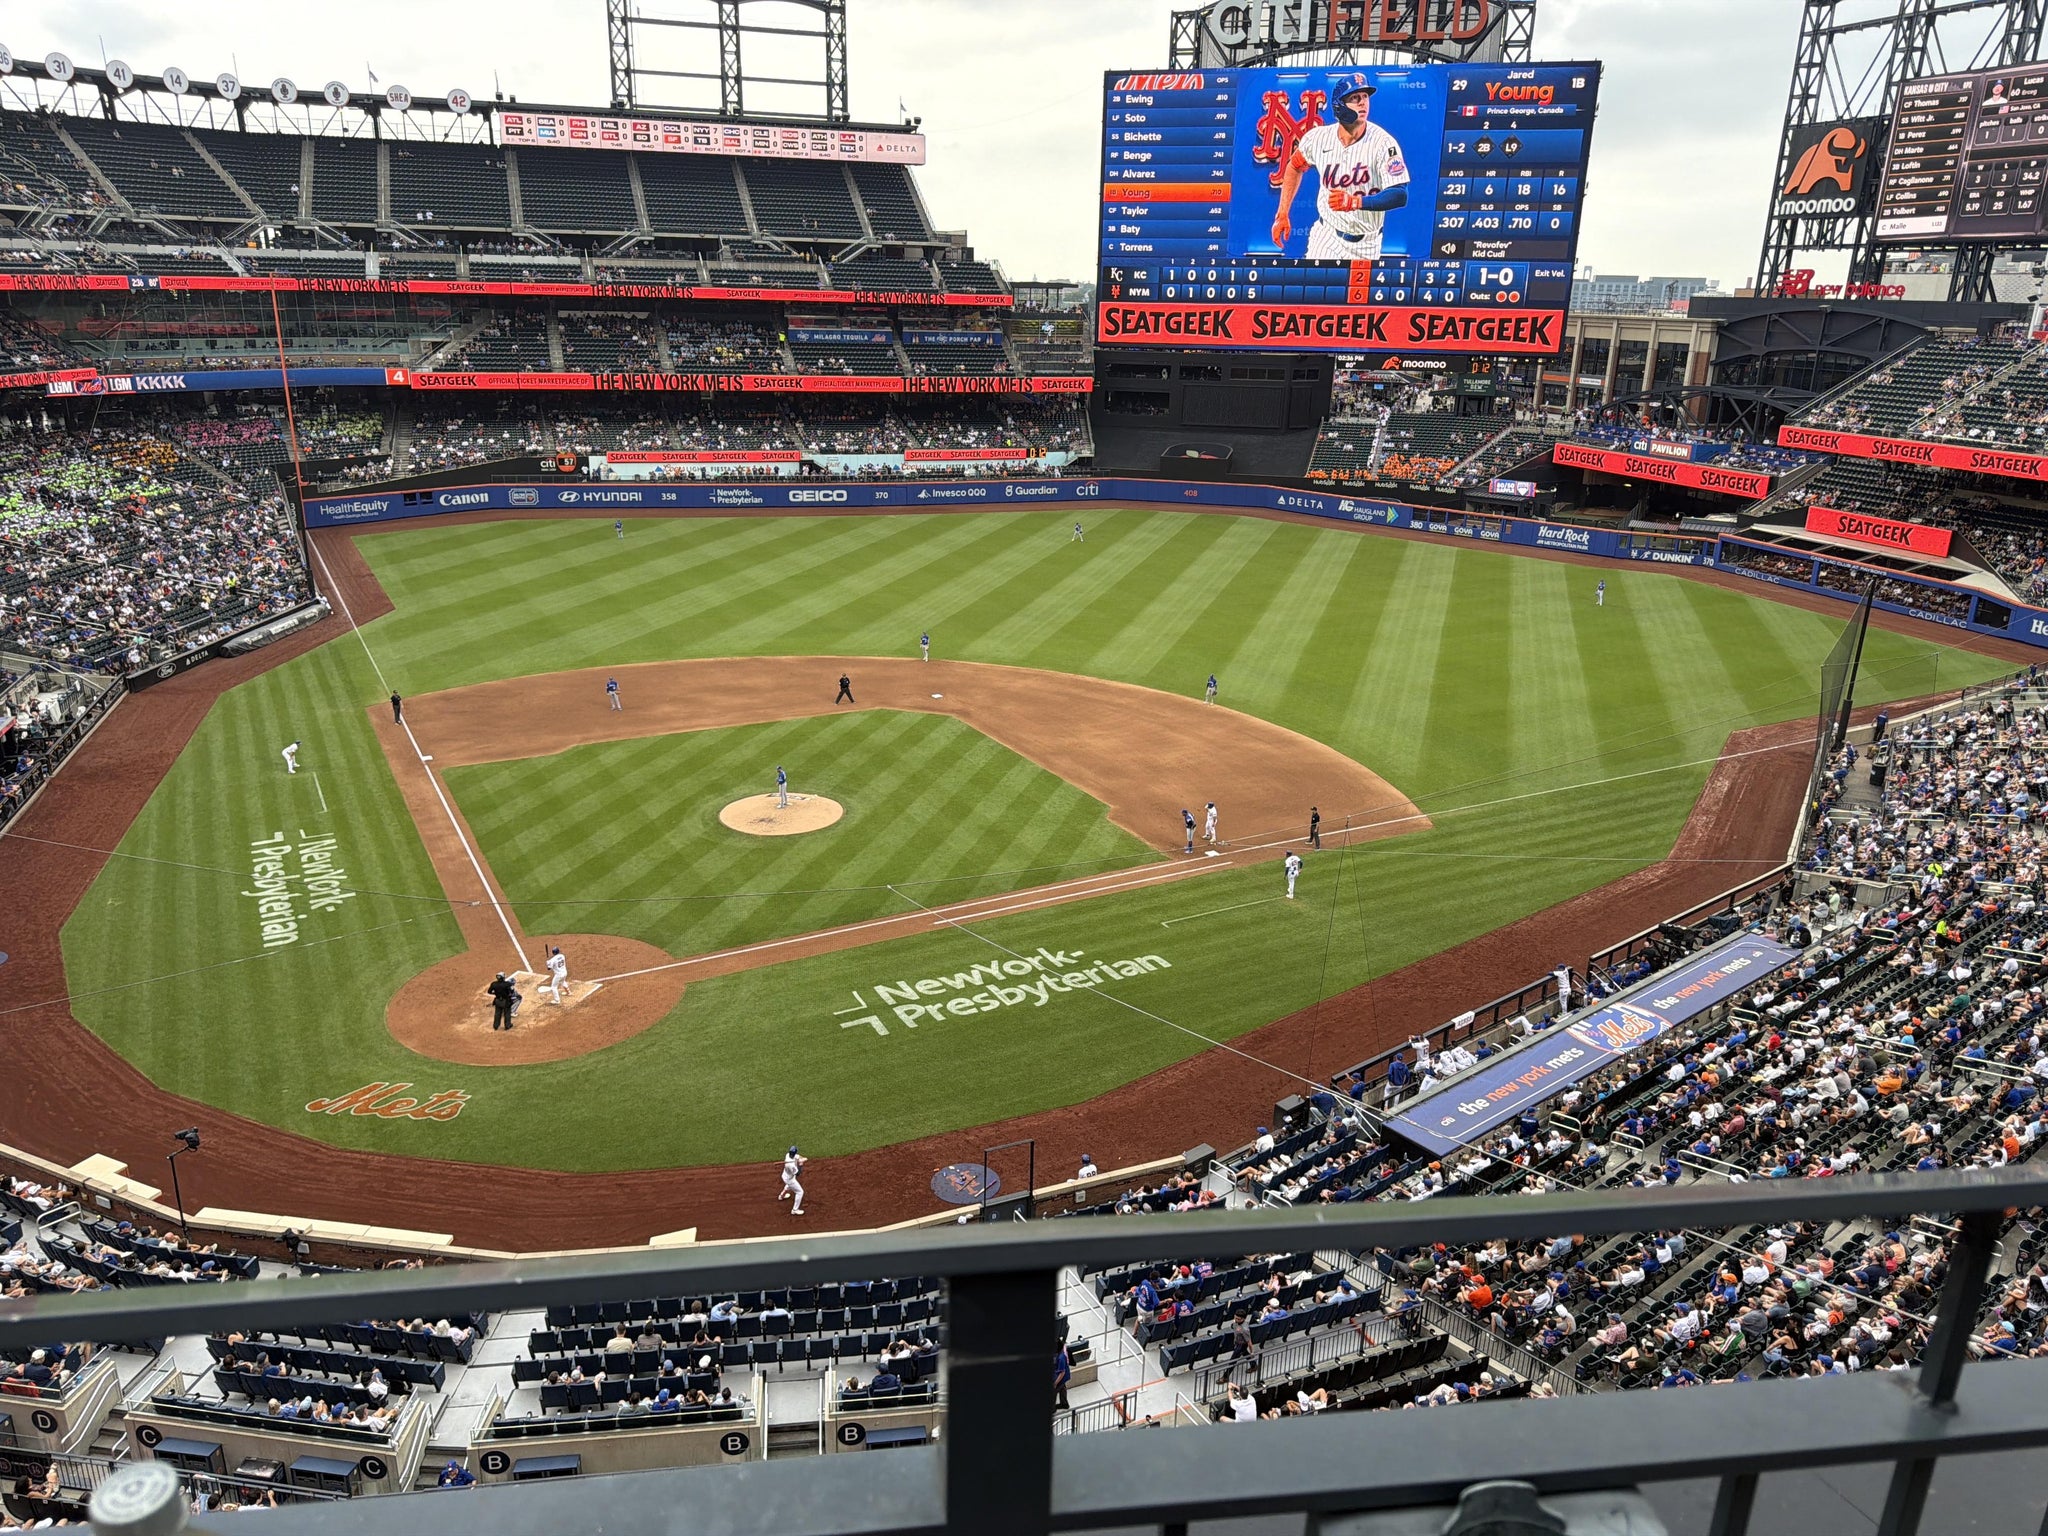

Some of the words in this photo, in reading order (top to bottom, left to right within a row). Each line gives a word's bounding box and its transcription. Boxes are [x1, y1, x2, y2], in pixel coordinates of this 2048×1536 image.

[1328, 0, 1489, 42] FIELD
[53, 60, 66, 74] 31
[113, 67, 126, 82] 41
[1507, 70, 1535, 80] Jared
[170, 74, 182, 87] 14
[1452, 80, 1468, 91] 29
[1572, 78, 1586, 89] 1B
[2024, 77, 2044, 85] Lucas
[222, 80, 235, 93] 37
[1904, 84, 1928, 95] KANSAS
[1934, 82, 1949, 93] CITY
[2011, 88, 2021, 96] 60
[389, 92, 409, 103] SHEA
[1485, 82, 1555, 106] Young
[451, 95, 466, 107] 42
[1125, 95, 1154, 106] Ewing
[1914, 99, 1939, 107] Thomas
[1486, 107, 1508, 115] Prince
[1509, 107, 1536, 116] George,
[1124, 114, 1146, 123] Soto
[1124, 132, 1162, 141] Bichette
[1907, 131, 1926, 139] Perez
[886, 144, 917, 152] DELTA
[1448, 143, 1466, 153] 1-2
[1477, 143, 1491, 152] 2B
[1505, 143, 1518, 152] L9
[1123, 151, 1152, 161] Benge
[1122, 170, 1155, 178] Alvarez
[1323, 163, 1370, 188] Mets
[1122, 188, 1150, 198] Young
[1443, 184, 1466, 195] .231
[1484, 184, 1493, 195] 6
[1517, 184, 1531, 195] 18
[1553, 184, 1566, 195] 16
[1896, 192, 1917, 200] Collins
[1780, 197, 1856, 215] moomoo
[1965, 203, 1980, 211] 5.19
[1993, 202, 2003, 210] 25
[2017, 201, 2032, 209] 1.67
[1121, 206, 1149, 217] Taylor
[1438, 217, 1465, 228] .307
[1471, 217, 1499, 229] .403
[1508, 218, 1532, 229] .710
[1550, 218, 1560, 229] 0
[1120, 225, 1141, 235] Baty
[1120, 243, 1153, 252] Torrens
[1472, 250, 1485, 258] Kid
[1487, 250, 1505, 258] Cudi
[1134, 271, 1147, 280] KC
[1480, 267, 1514, 286] 1-0
[1535, 270, 1549, 278] Exit
[1550, 270, 1566, 278] Vel.
[1129, 288, 1150, 297] NYM
[1814, 284, 1843, 296] new
[1845, 281, 1906, 297] balance
[1105, 308, 1234, 339] SEATGEEK
[1252, 310, 1390, 342] SEATGEEK
[1408, 313, 1554, 346] SEATGEEK
[813, 333, 841, 341] MILAGRO
[49, 382, 73, 394] LGM
[109, 378, 132, 391] LGM
[136, 375, 186, 390] KKKK
[419, 375, 477, 387] SEATGEEK
[591, 374, 620, 390] THE
[621, 374, 656, 390] NEW
[657, 374, 700, 391] YORK
[701, 374, 744, 391] METS
[754, 378, 803, 389] SEATGEEK
[1634, 438, 1647, 450] citi
[1651, 445, 1688, 458] PAVILION
[1786, 429, 1841, 450] SEATGEEK
[1872, 440, 1934, 462] SEATGEEK
[1970, 452, 2043, 476] SEATGEEK
[1559, 447, 1604, 469] SEATGEEK
[1625, 458, 1678, 481] SEATGEEK
[1700, 470, 1761, 495] SEATGEEK
[716, 489, 753, 497] NewYork-
[932, 489, 967, 498] Invesco
[968, 488, 986, 497] QQQ
[1015, 486, 1058, 496] Guardian
[1076, 481, 1099, 496] citi
[1183, 489, 1198, 497] 408
[439, 492, 489, 506] Canon
[583, 492, 642, 502] HYUNDAI
[661, 493, 677, 501] 358
[717, 496, 763, 505] Presbyterian
[788, 489, 848, 502] GEICO
[875, 491, 889, 499] 370
[320, 500, 388, 515] HealthEquity
[1288, 497, 1323, 510] DELTA
[1353, 513, 1373, 522] GROUP
[1354, 507, 1386, 517] HAUGLAND
[1410, 521, 1423, 530] 380
[1429, 523, 1448, 532] GOYA
[1837, 515, 1914, 546] SEATGEEK
[1538, 526, 1565, 539] Hard
[1566, 529, 1590, 545] Rock
[1652, 553, 1695, 564] DUNKIN'
[1703, 557, 1714, 567] 370
[1735, 567, 1780, 585] CADILLAC
[1908, 609, 1968, 629] CADILLAC
[299, 838, 356, 912] NewYork-
[241, 844, 308, 948] Presbyterian
[873, 947, 1085, 1005] NewYork-
[1652, 995, 1680, 1011] the
[1674, 981, 1702, 999] new
[1699, 970, 1727, 989] york
[1721, 956, 1752, 975] mets
[892, 952, 1172, 1028] Presbyterian
[1607, 1014, 1656, 1048] Mets
[1457, 1098, 1490, 1116] the
[1485, 1081, 1520, 1102] new
[1516, 1065, 1552, 1087] york
[1546, 1046, 1585, 1070] mets
[305, 1081, 472, 1122] Mets
[37, 1414, 52, 1430] D
[143, 1428, 157, 1445] C
[844, 1427, 859, 1441] B
[727, 1435, 742, 1450] B
[365, 1459, 381, 1476] C
[487, 1455, 503, 1470] B
